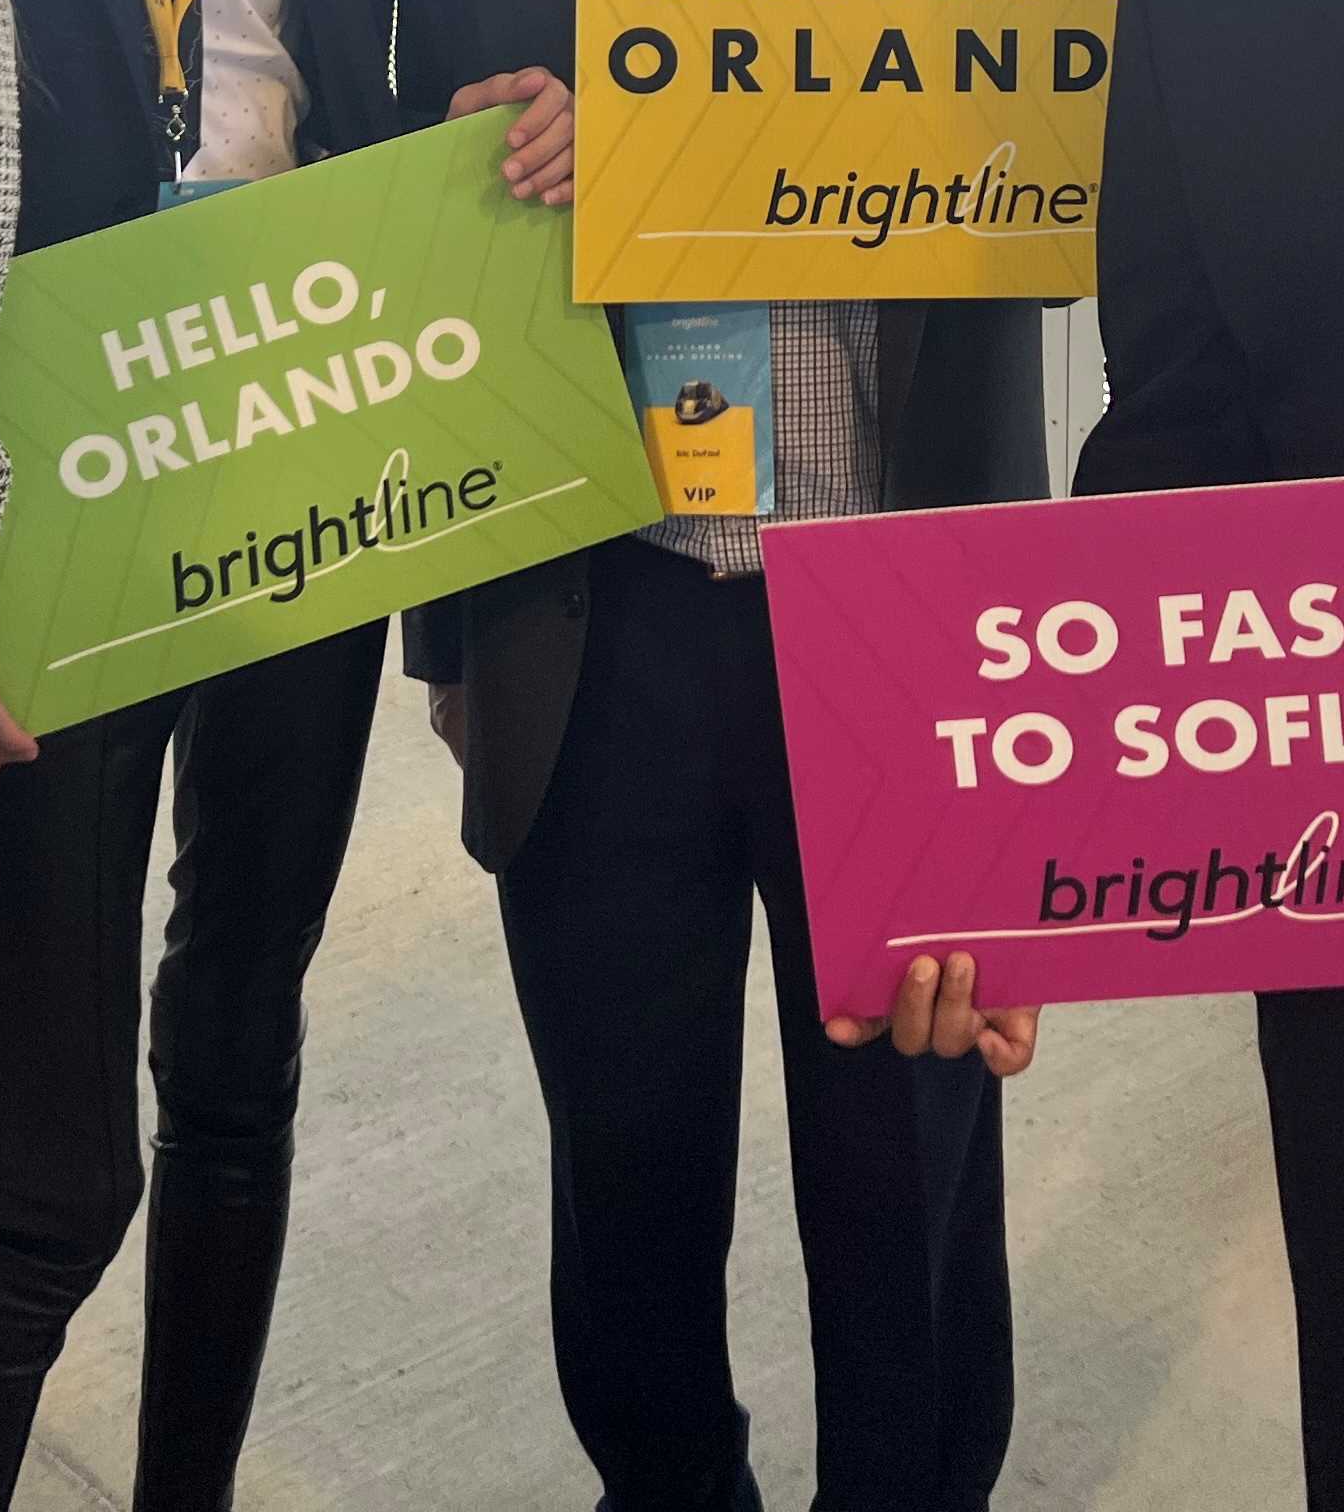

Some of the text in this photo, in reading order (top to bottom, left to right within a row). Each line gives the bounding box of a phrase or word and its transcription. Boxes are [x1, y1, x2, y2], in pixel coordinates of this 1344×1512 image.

[608, 27, 1110, 95] ORLAND
[764, 164, 1090, 249] brightline
[100, 260, 387, 392] HELLO,
[57, 316, 482, 500] ORLANDO
[683, 487, 717, 502] VIP
[171, 466, 498, 615] brightline
[975, 600, 1120, 681] SO
[935, 712, 1074, 788] TO
